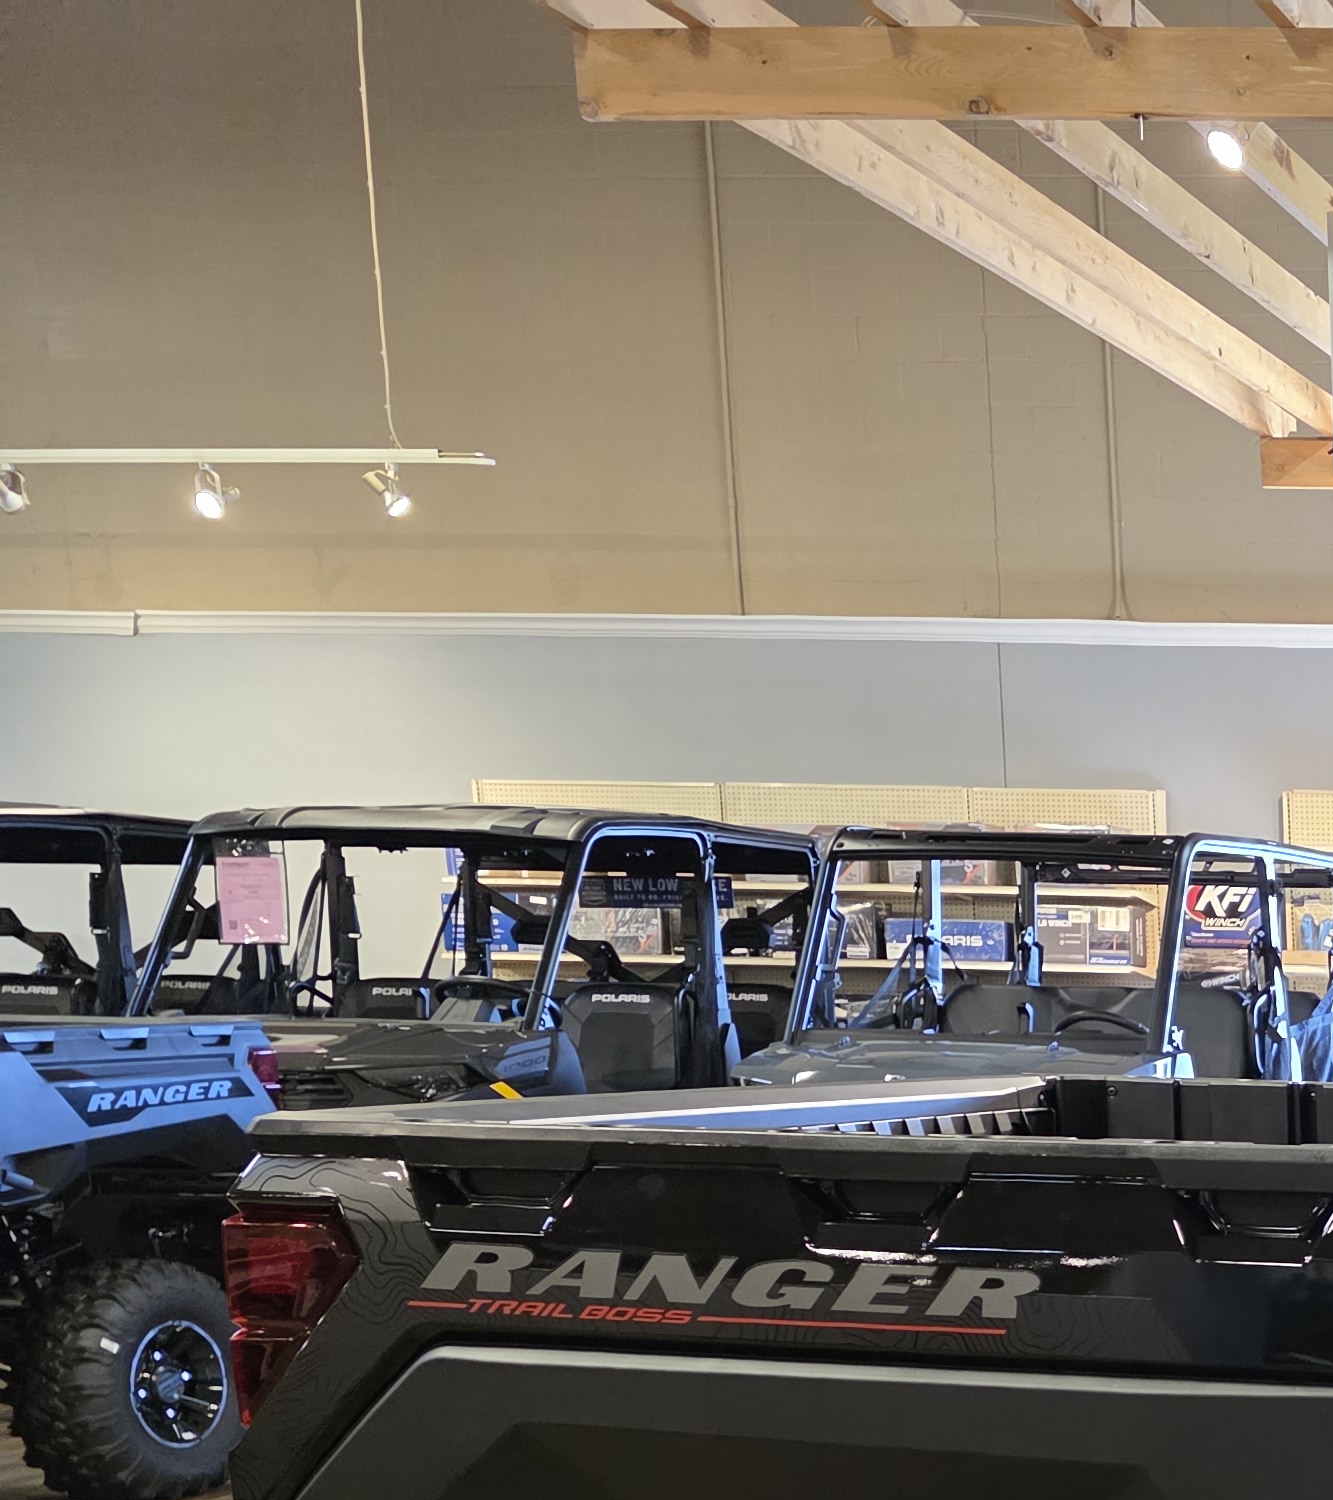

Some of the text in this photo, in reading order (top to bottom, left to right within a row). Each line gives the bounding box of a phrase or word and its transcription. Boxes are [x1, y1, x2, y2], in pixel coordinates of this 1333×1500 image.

[613, 878, 644, 892] NEW
[648, 878, 679, 892] LOW
[1204, 917, 1247, 928] WINCH
[1, 985, 59, 996] POLARIS
[591, 993, 650, 1004] POLARIS
[87, 1080, 232, 1113] RANGER
[419, 1241, 1041, 1320] RANGER
[466, 1298, 694, 1325] TRAIL BOSS
